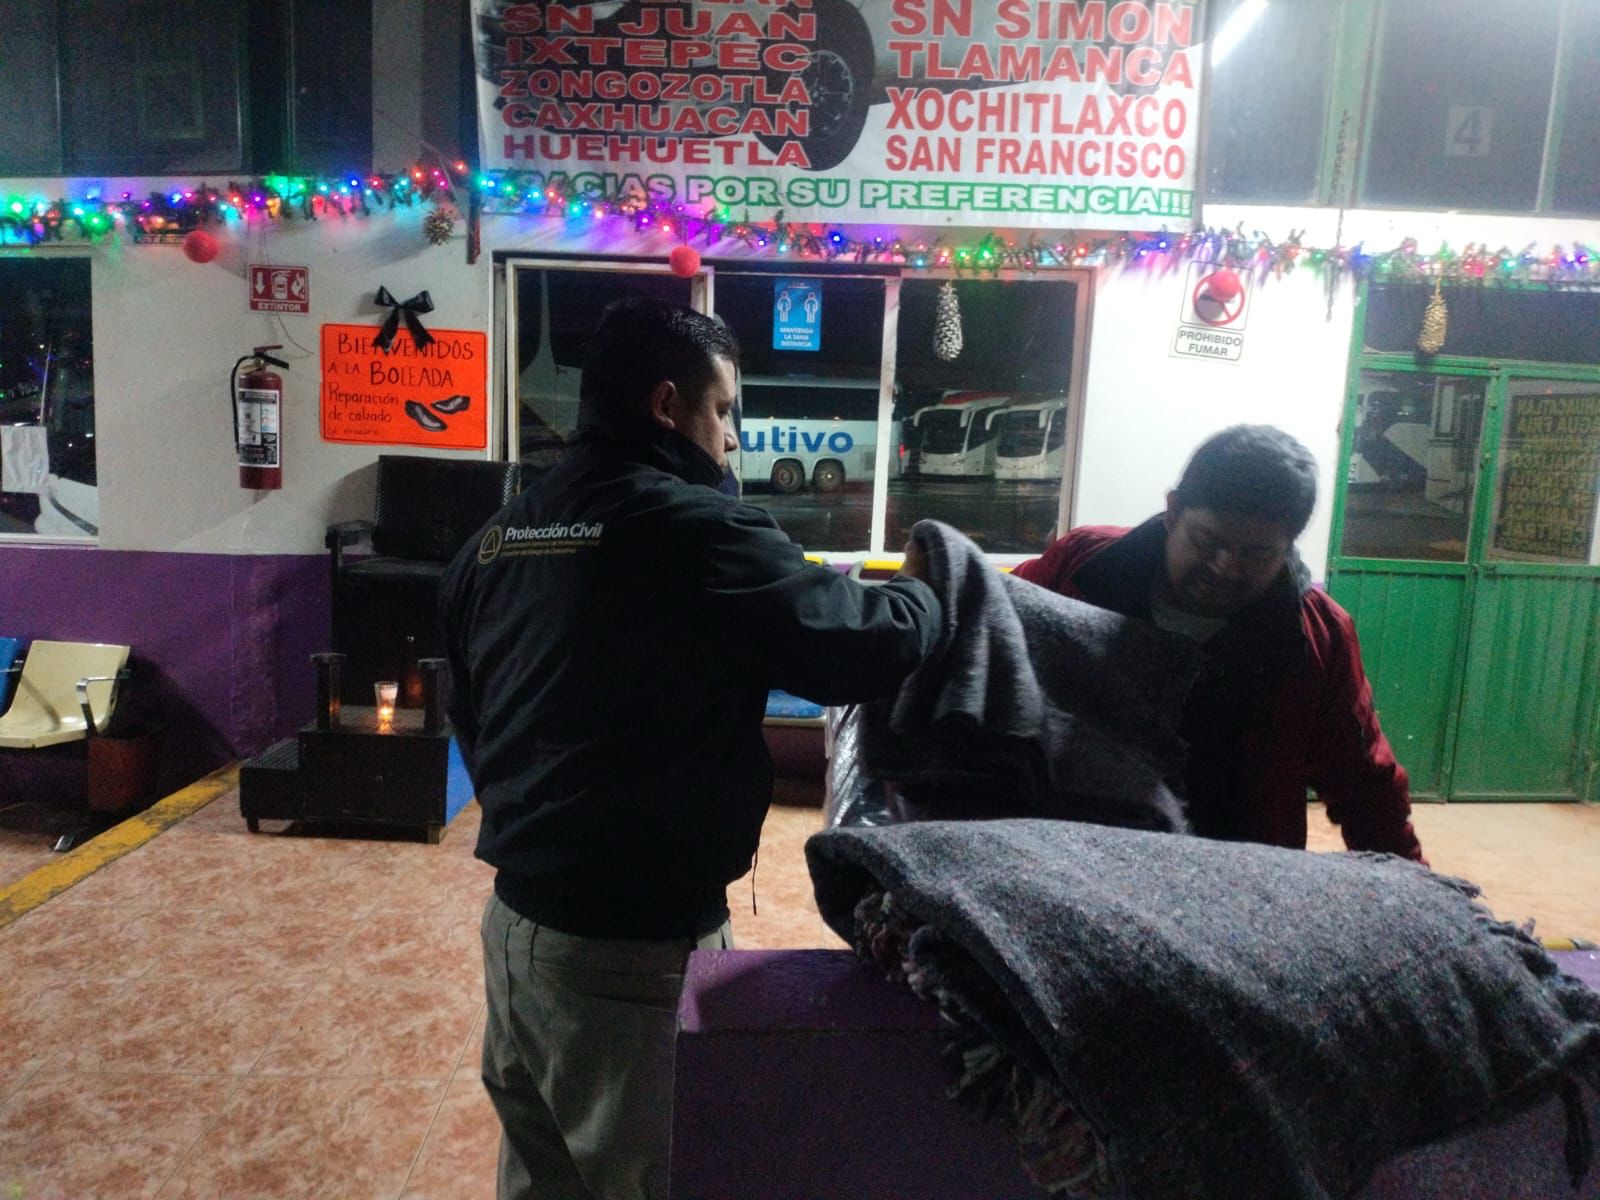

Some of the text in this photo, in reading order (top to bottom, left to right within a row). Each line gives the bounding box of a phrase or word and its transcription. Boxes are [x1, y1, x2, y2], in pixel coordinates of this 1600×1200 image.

[501, 4, 816, 41] SN JUAN
[889, 0, 1192, 47] SN SIMON
[504, 37, 811, 71] IXTEPEC
[888, 40, 1194, 89] TLAMANCA
[500, 70, 812, 104] ZONGOZOTLA
[501, 103, 809, 136] CAXHUACAN
[885, 87, 1187, 139] XOCHITLAXCO
[1454, 109, 1483, 154] 4
[503, 134, 811, 168] HUEHUETLA
[885, 135, 1185, 180] SAN FRANCISCO
[686, 175, 780, 207] POR
[786, 177, 850, 208] SU
[860, 179, 1194, 217] PREFERENCIA!!!
[258, 302, 301, 311] EXTINTOR
[1179, 329, 1242, 346] PROHIBIDO
[1188, 343, 1228, 357] FUMAR
[328, 361, 454, 387] A LA BOLEADA
[328, 382, 399, 408] Reparación
[328, 404, 392, 423] de calzado
[740, 426, 854, 453] utivo
[505, 521, 603, 541] Protección Civil
